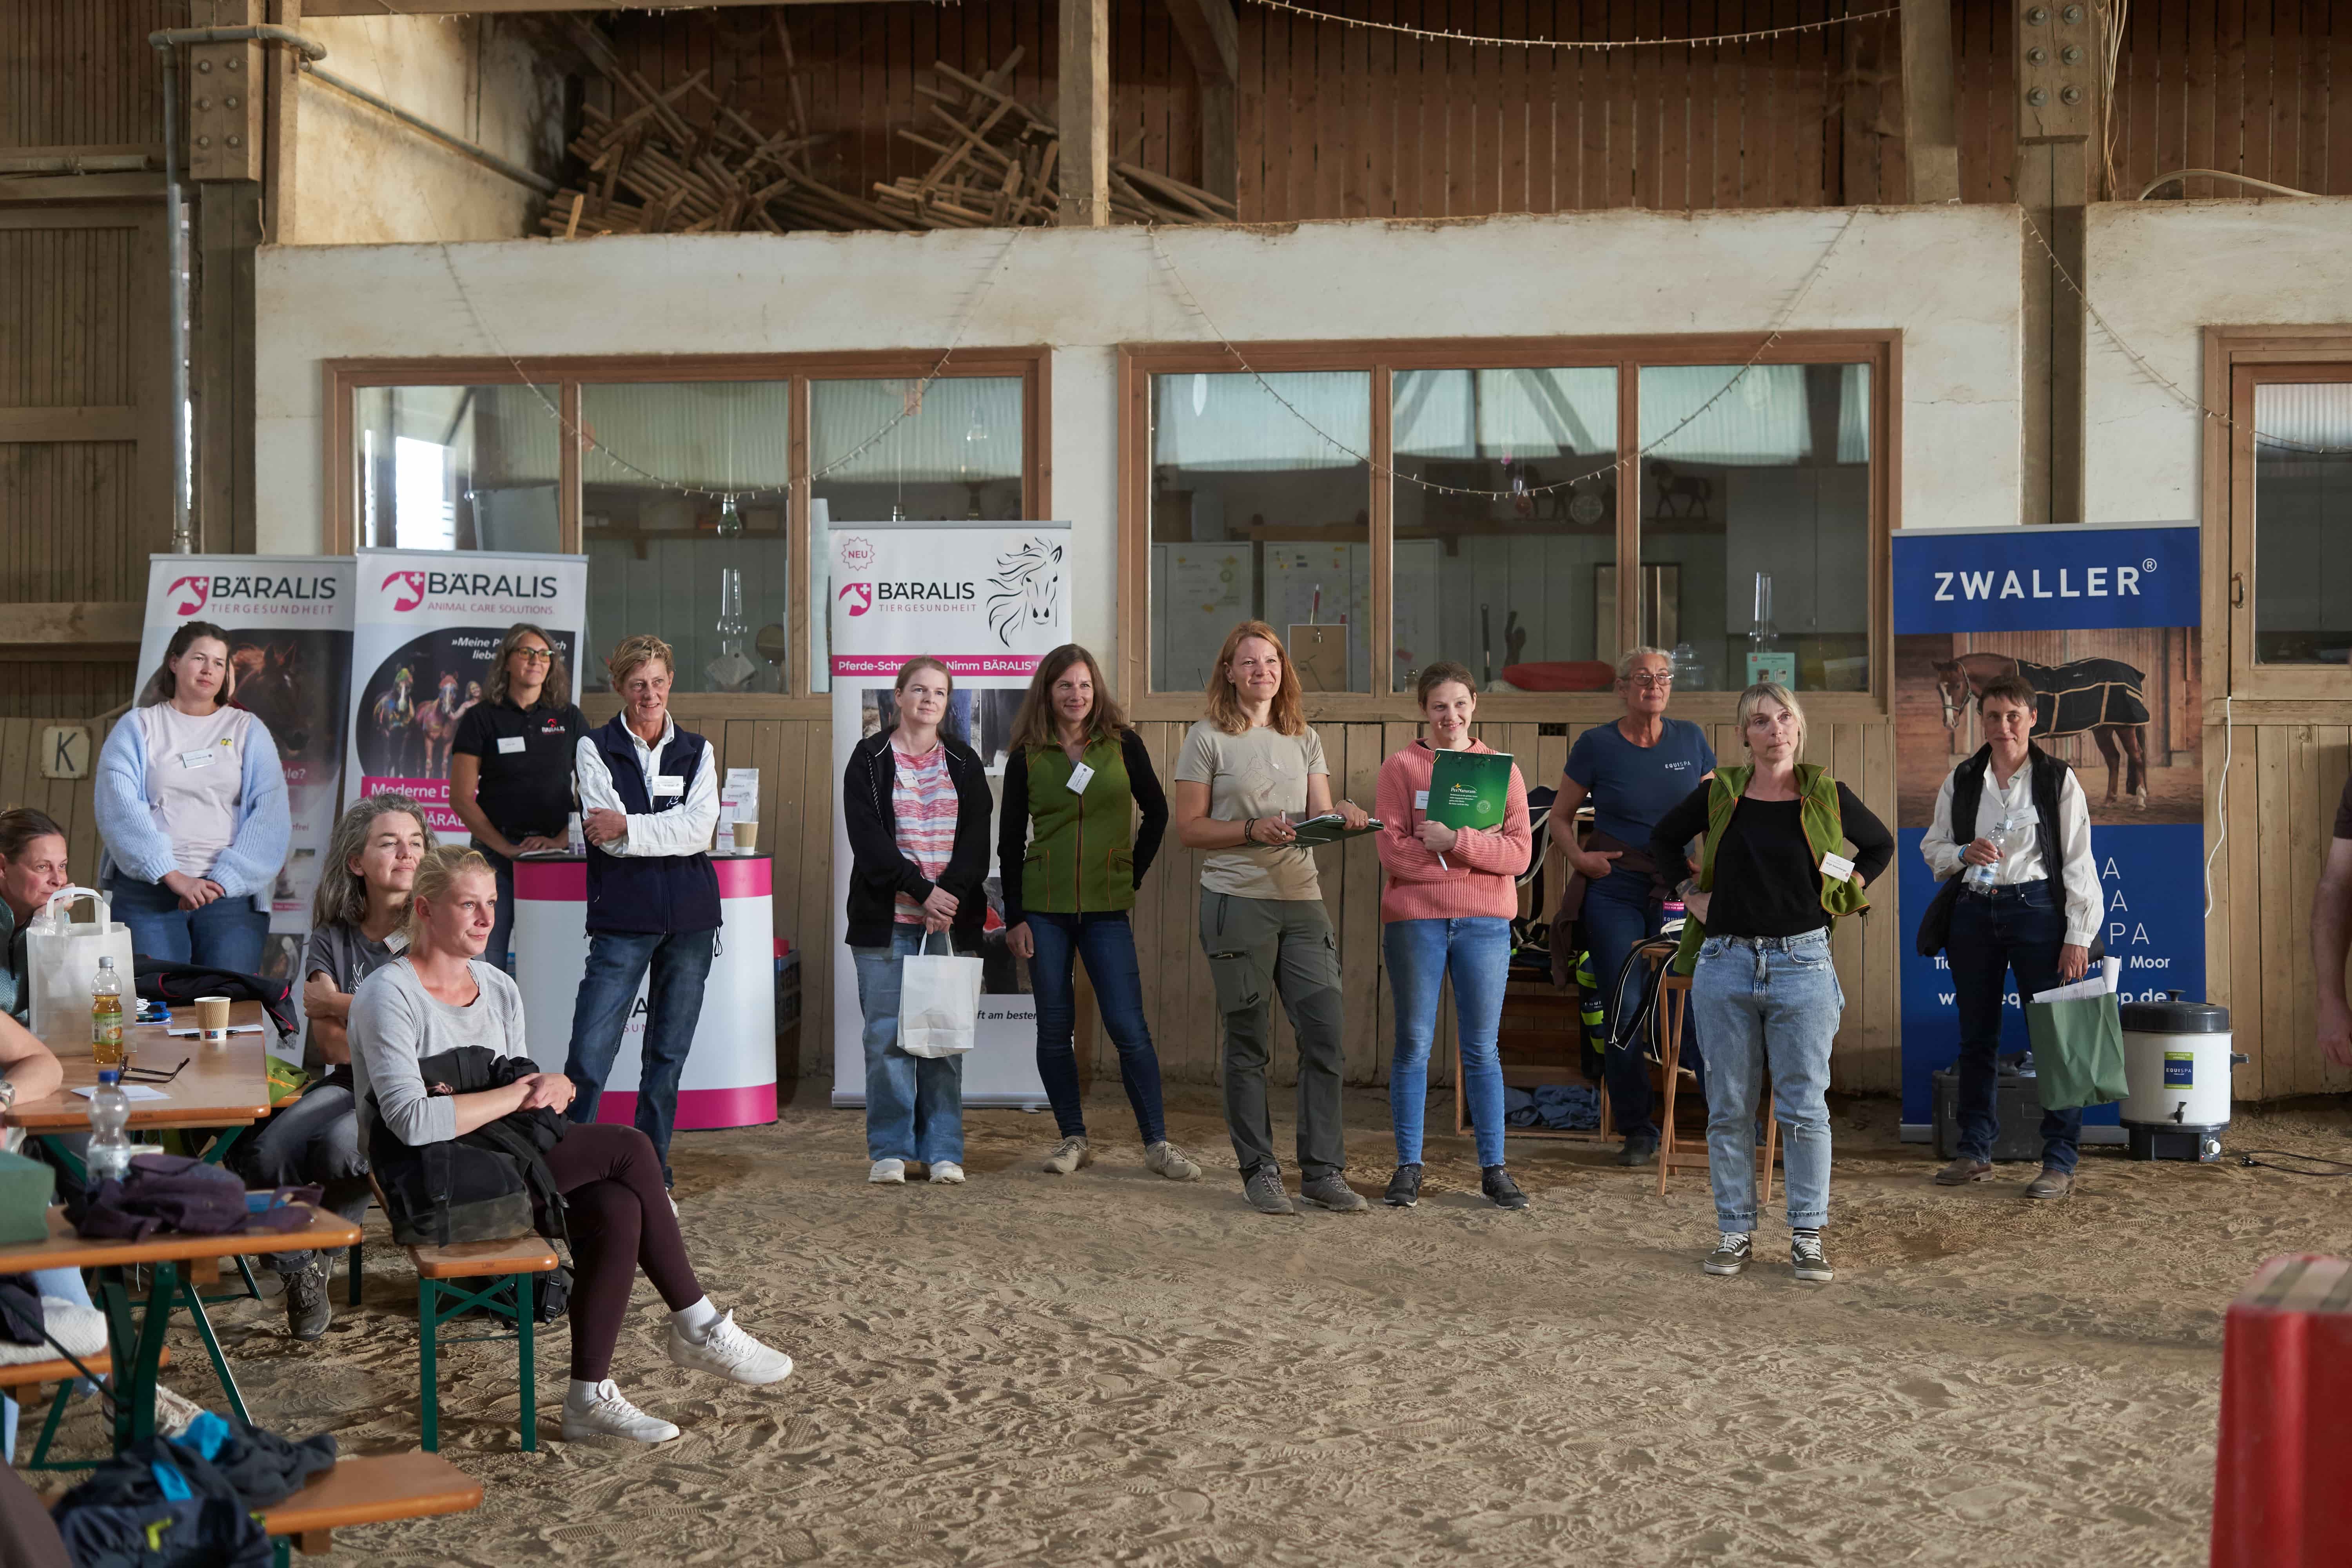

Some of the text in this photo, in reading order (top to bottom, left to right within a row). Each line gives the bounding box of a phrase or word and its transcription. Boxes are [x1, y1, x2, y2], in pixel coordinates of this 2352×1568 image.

[848, 550, 868, 559] NEU
[212, 576, 336, 599] BÄRALIS
[428, 572, 557, 598] BÄRALIS
[878, 582, 975, 600] BÄRALIS
[211, 603, 334, 615] TIERGESUNDHEIT
[427, 602, 467, 612] ANIMAL
[470, 603, 496, 613] CARE
[879, 604, 976, 612] TIERGESUNDHEIT
[838, 661, 905, 671] Pferde-Schr
[946, 661, 980, 671] Nimm
[55, 731, 77, 772] K
[427, 811, 465, 827] ÄRAL
[2110, 922, 2150, 945] PA
[2130, 955, 2171, 969] Moor
